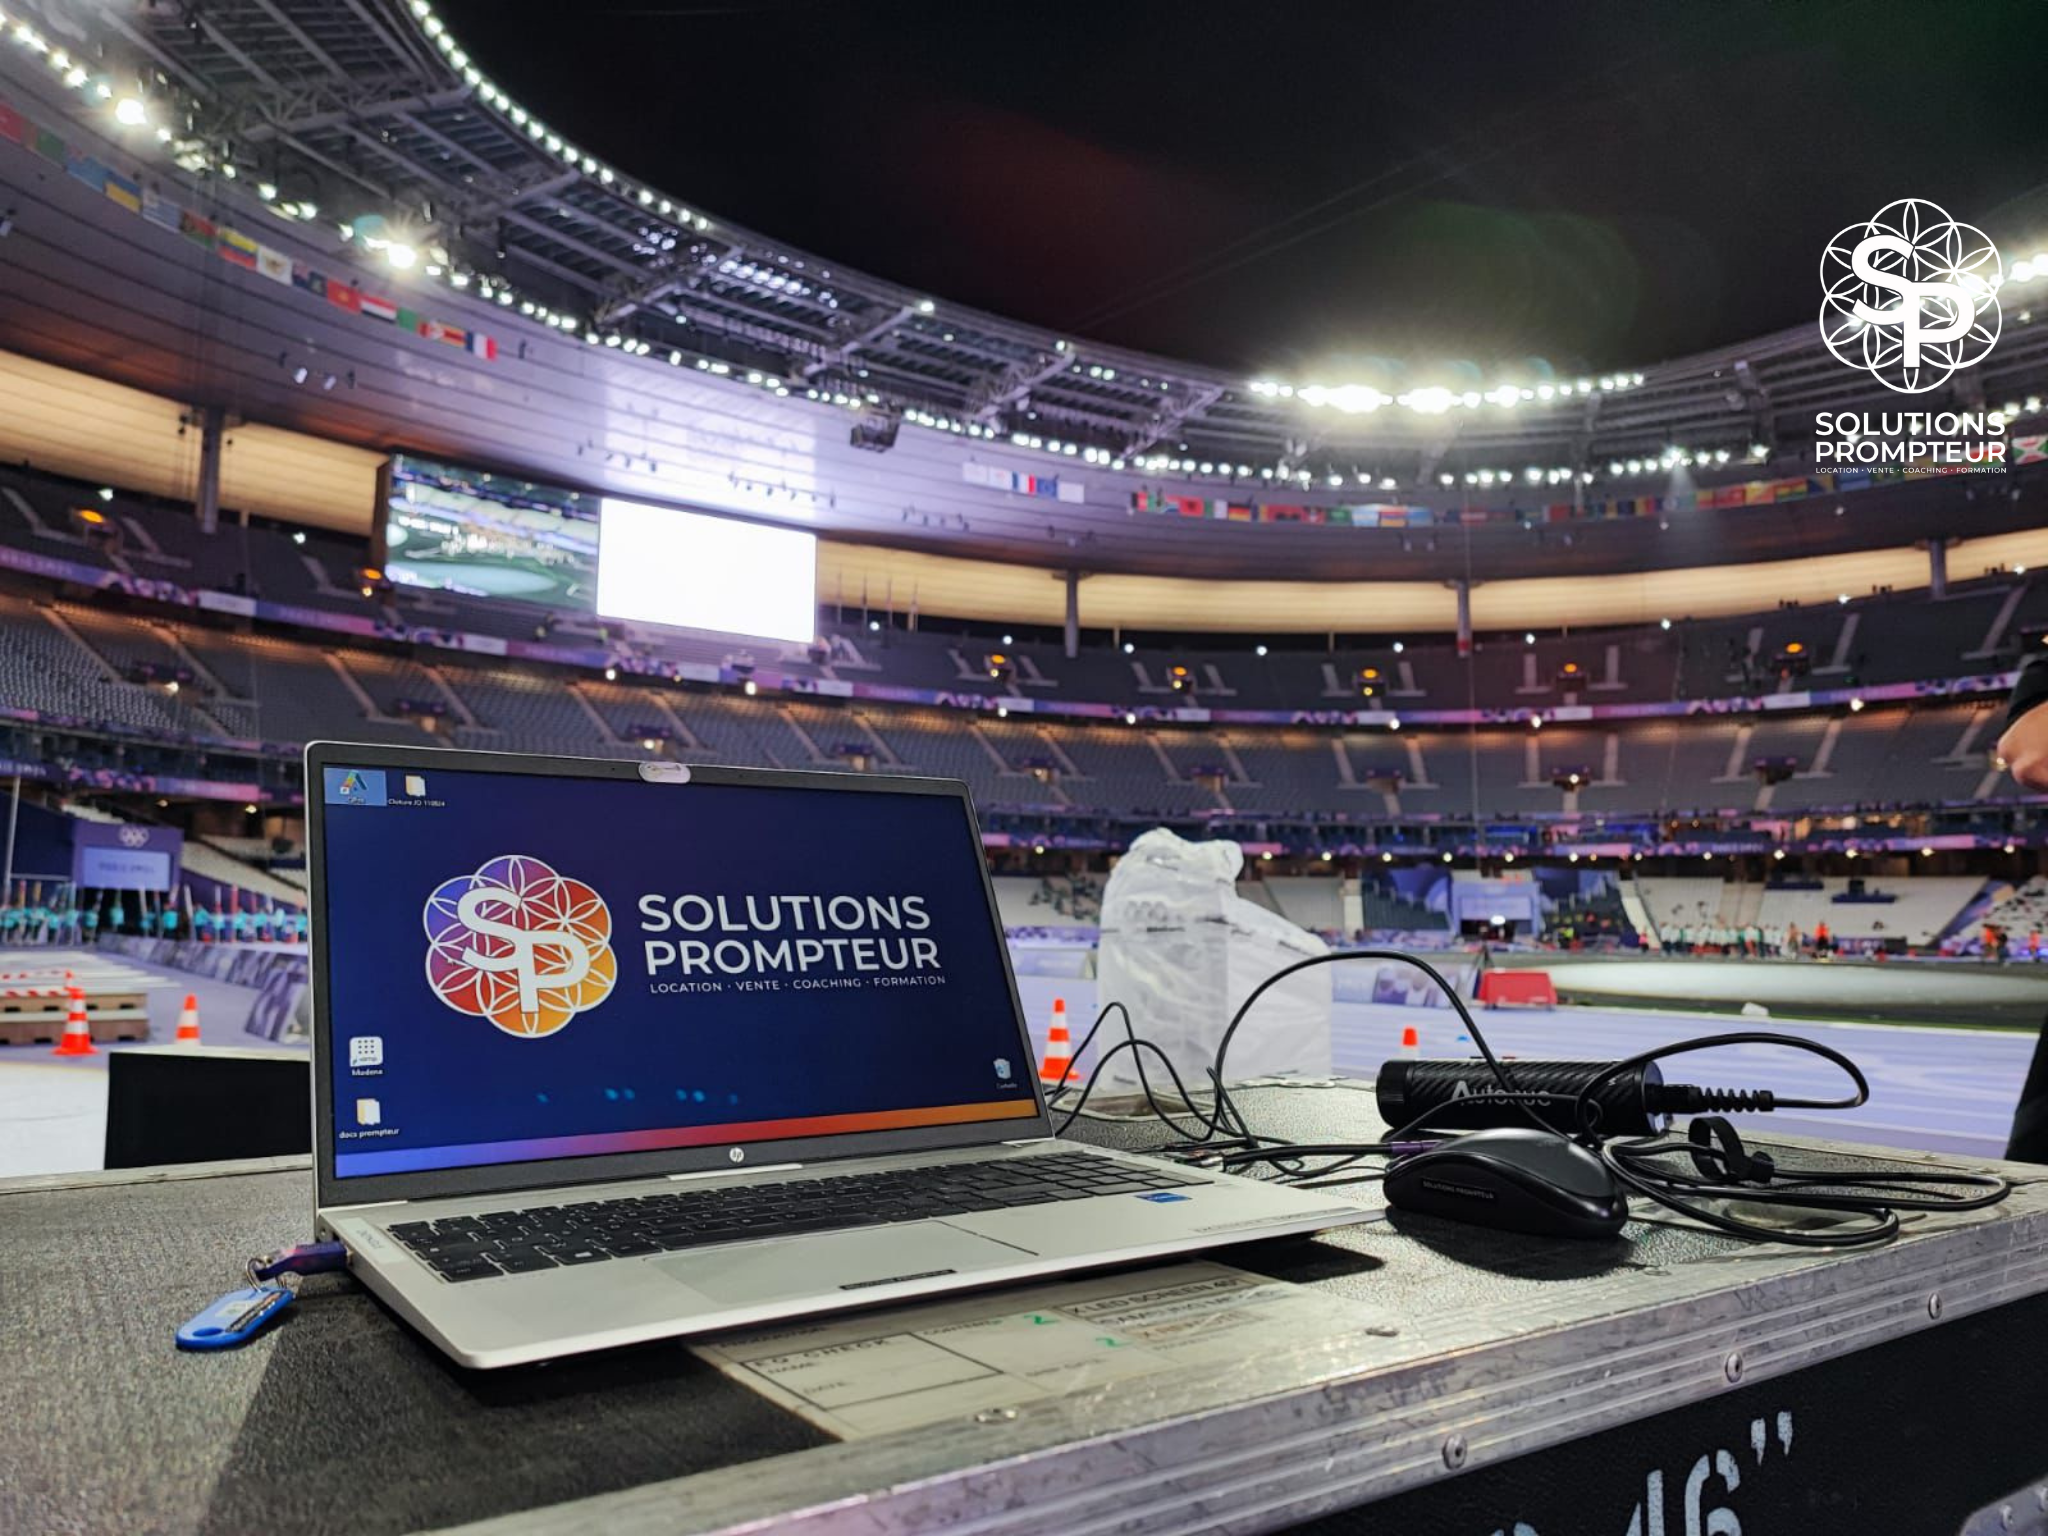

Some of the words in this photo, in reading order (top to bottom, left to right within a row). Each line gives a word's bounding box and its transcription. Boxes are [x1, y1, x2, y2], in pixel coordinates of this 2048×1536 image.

[638, 894, 931, 932] SOLUTIONS
[457, 886, 591, 1014] SP
[644, 937, 942, 976] PROMPTEUR
[650, 981, 723, 994] LOCATION
[735, 980, 781, 992] VENTE
[793, 978, 862, 989] COACHING
[874, 975, 946, 987] FORMATION
[1451, 1080, 1551, 1107] Autoue
